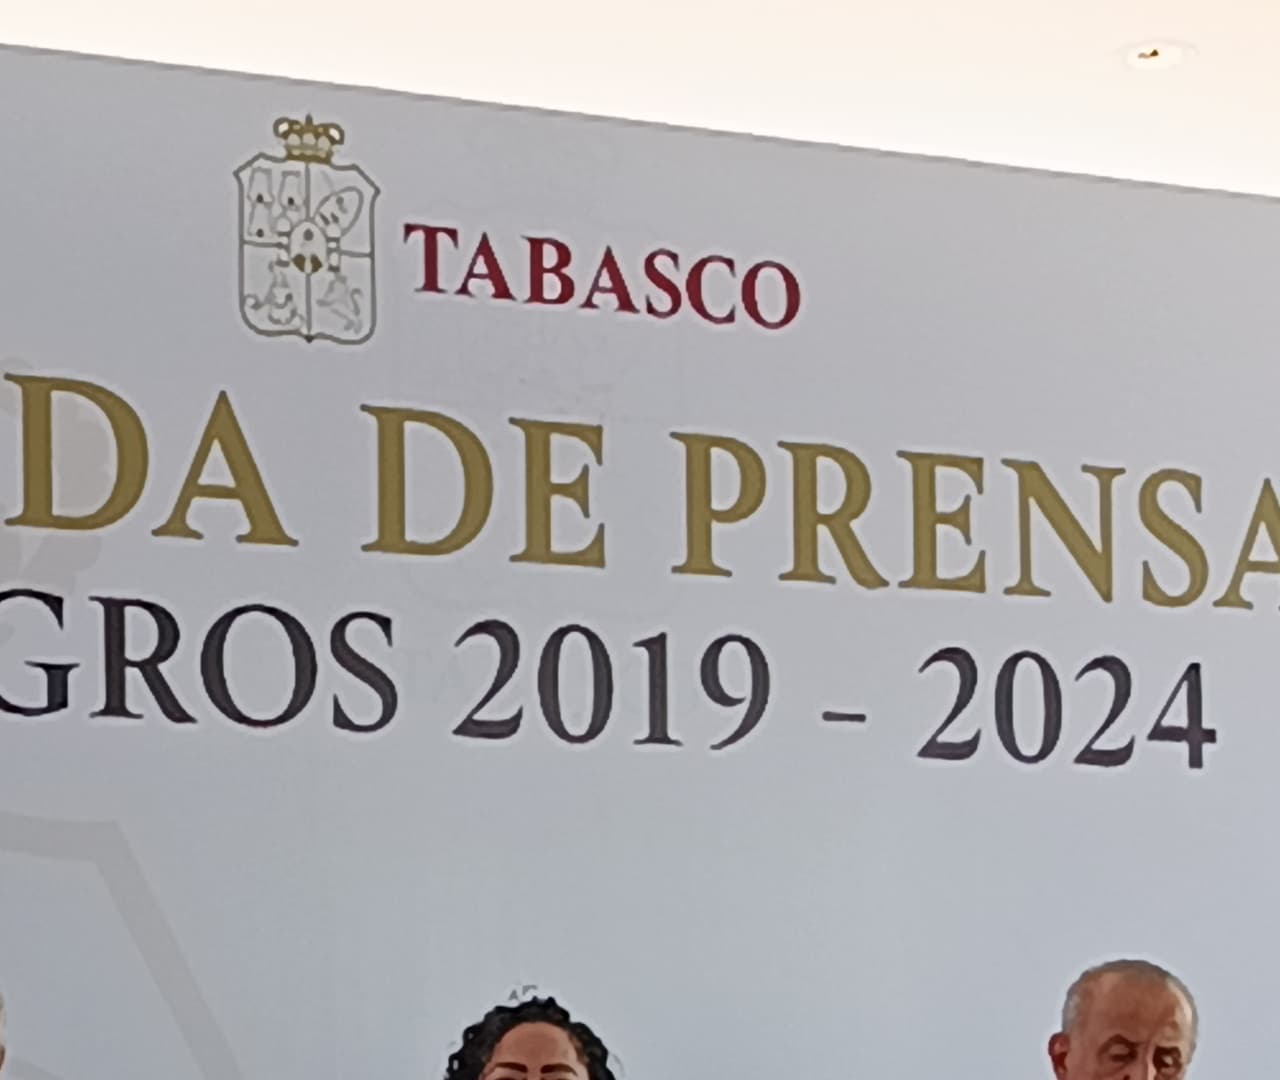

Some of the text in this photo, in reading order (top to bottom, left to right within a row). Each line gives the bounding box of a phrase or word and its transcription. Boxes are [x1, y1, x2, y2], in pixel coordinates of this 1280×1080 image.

[404, 222, 801, 330] TABASCO
[360, 403, 606, 569] DE
[452, 619, 770, 751] 2019
[822, 710, 867, 723] -
[917, 646, 1217, 770] 2024
